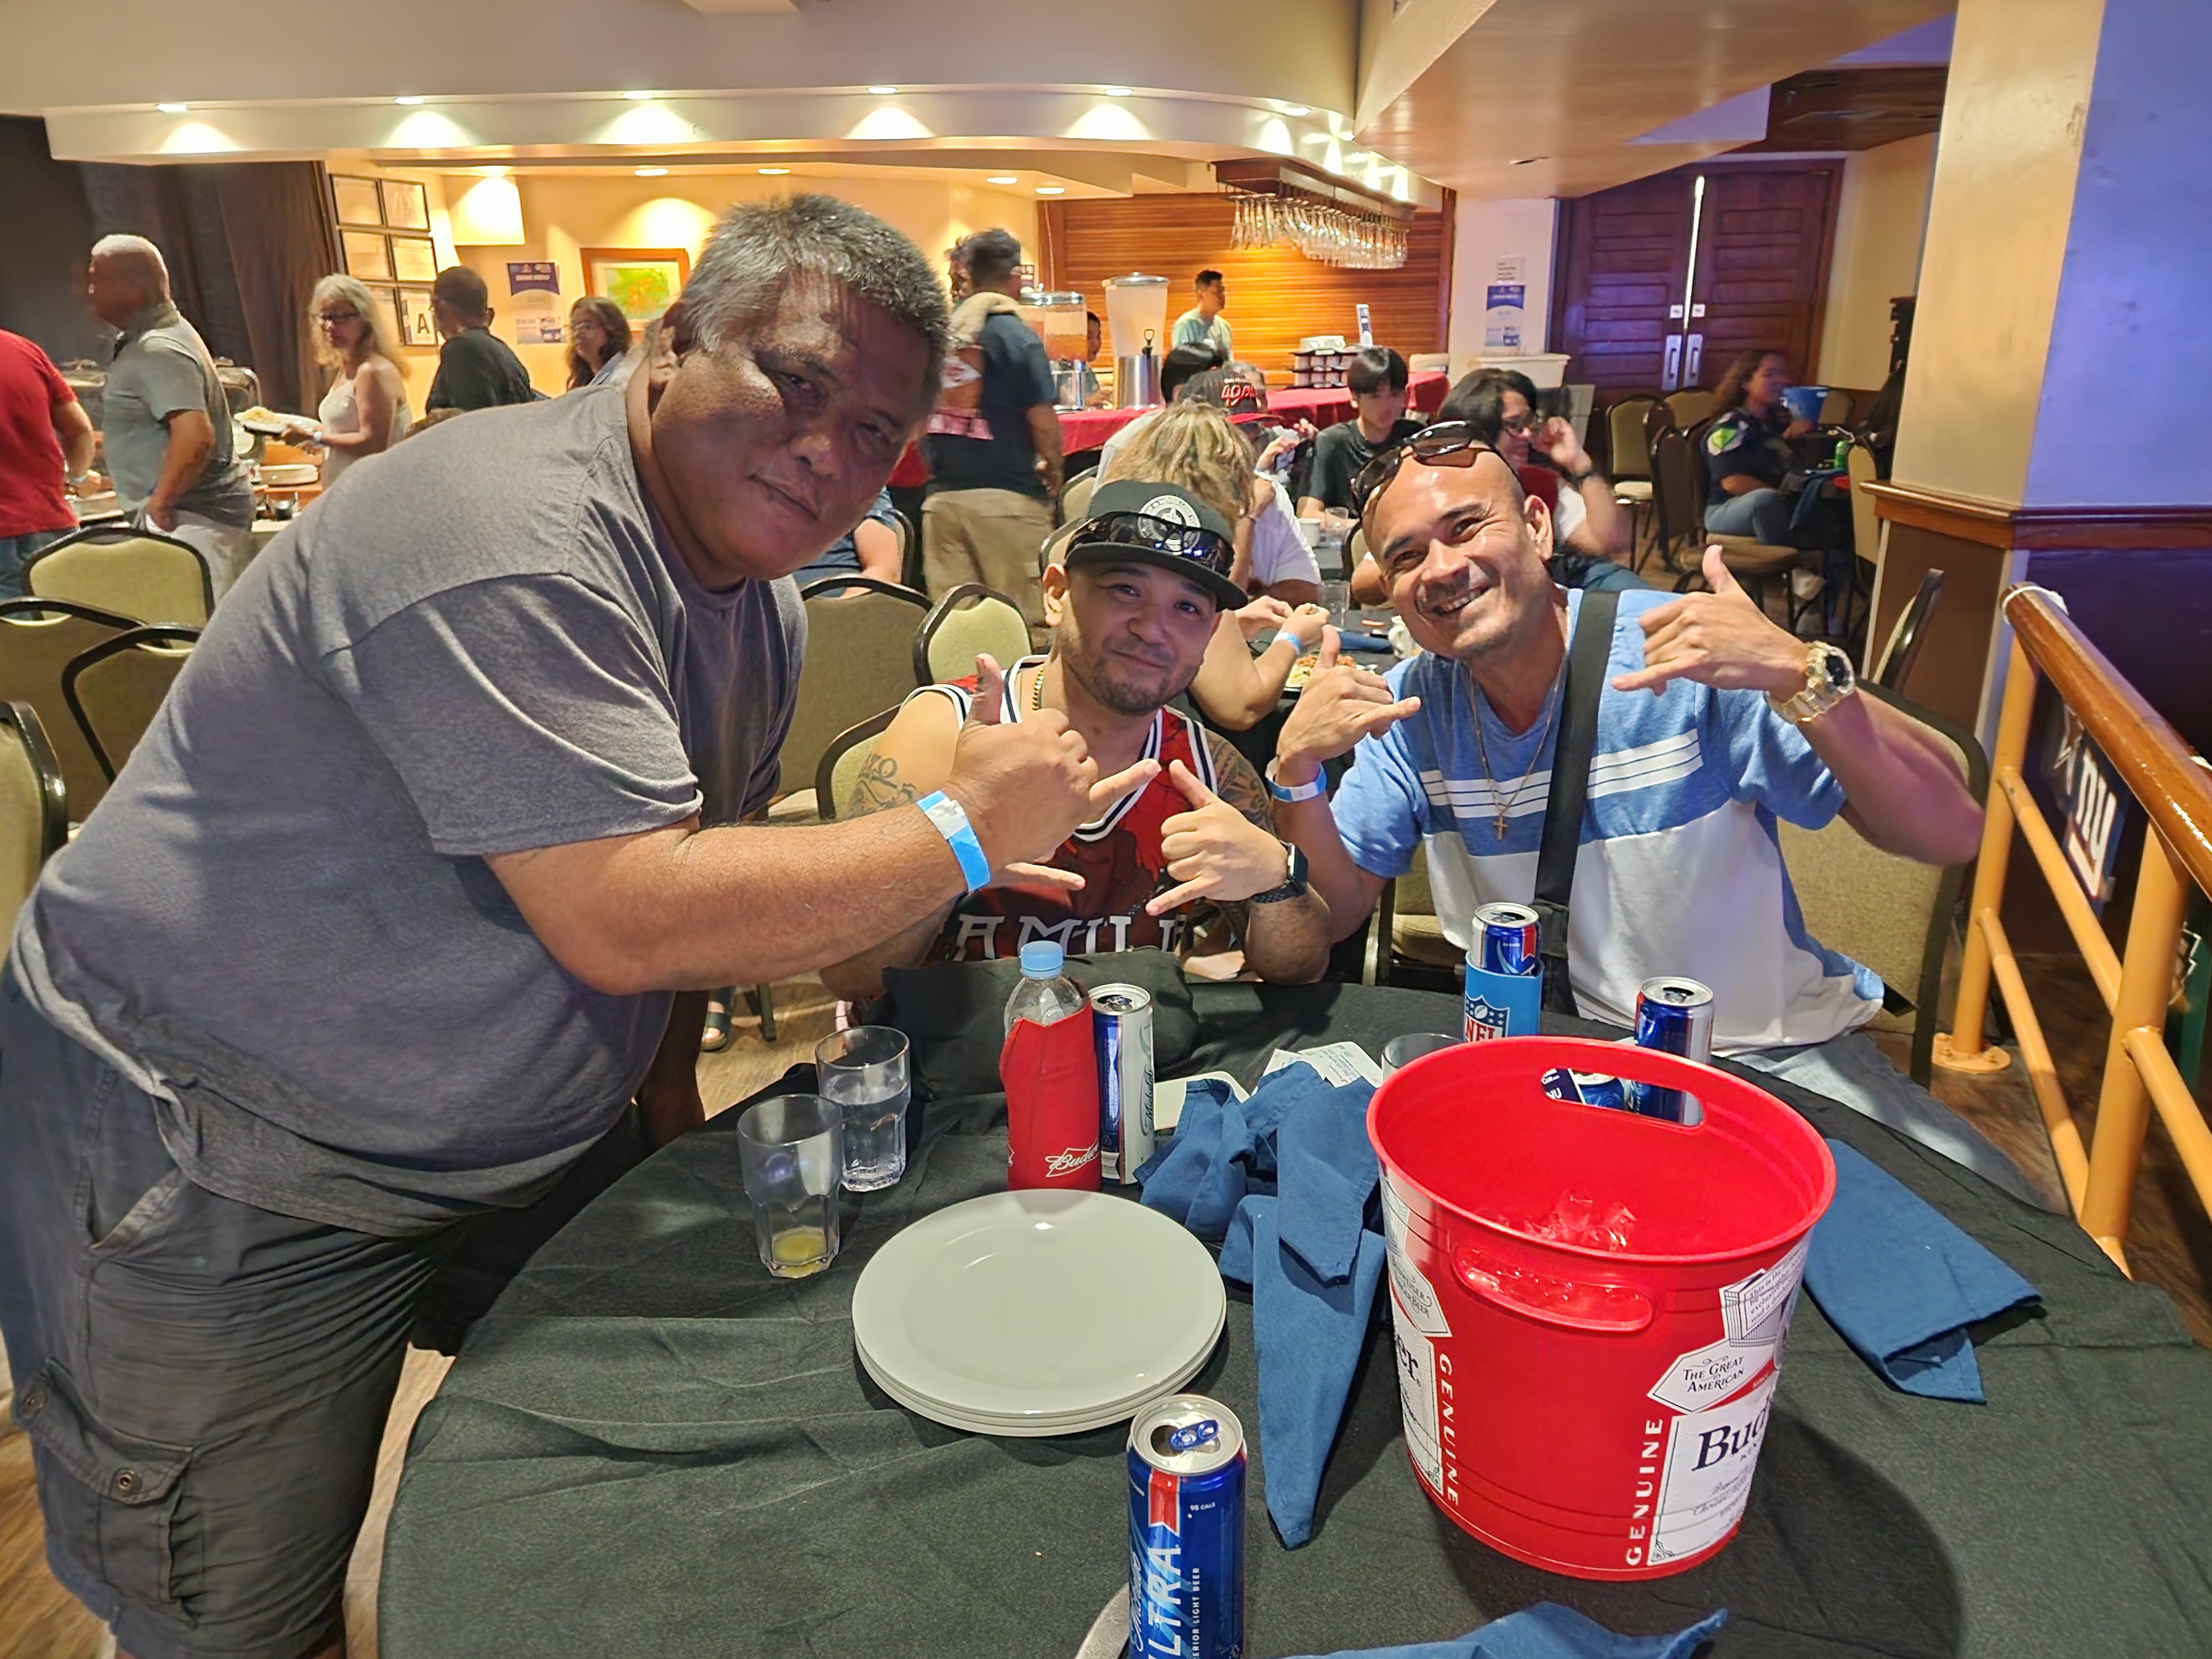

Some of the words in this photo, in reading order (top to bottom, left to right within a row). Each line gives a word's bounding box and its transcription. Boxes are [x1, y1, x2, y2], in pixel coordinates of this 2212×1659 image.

[417, 313, 430, 334] A
[1683, 1369, 1705, 1381] THE
[1709, 1357, 1745, 1375] GREAT
[1687, 1368, 1745, 1392] AMERICAN
[1439, 1353, 1458, 1506] GENUINE
[1626, 1418, 1663, 1566] GENUINE
